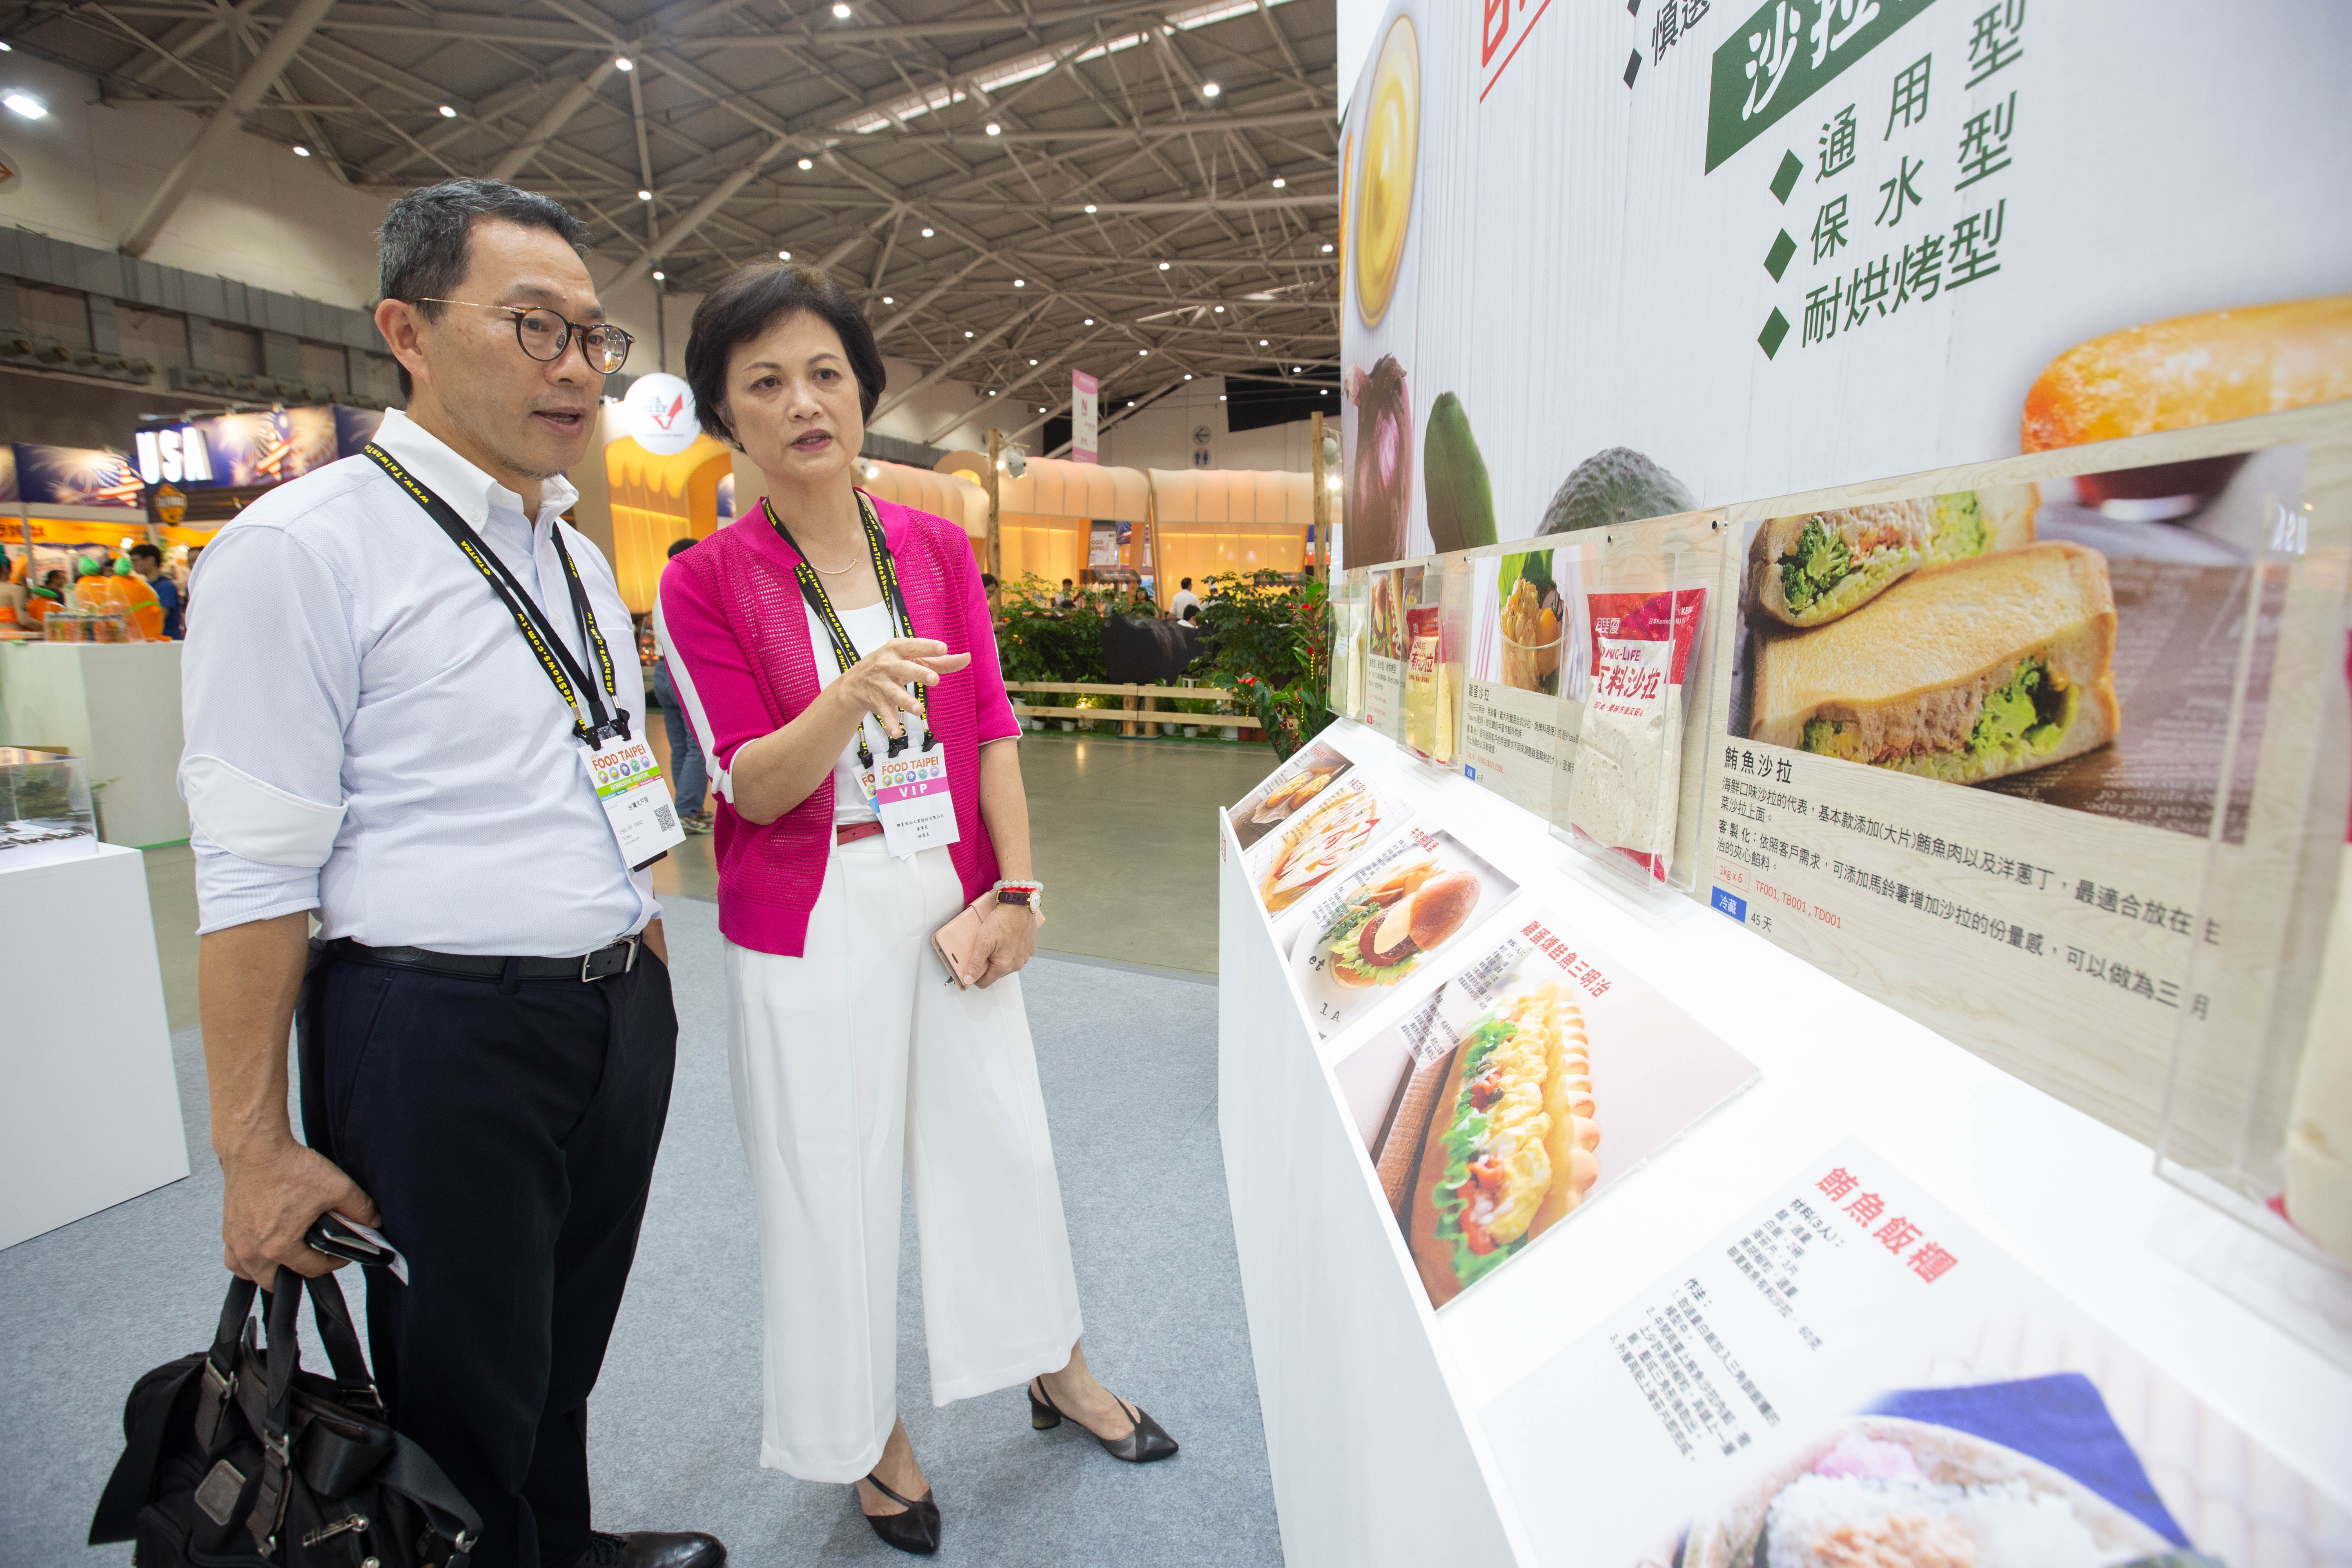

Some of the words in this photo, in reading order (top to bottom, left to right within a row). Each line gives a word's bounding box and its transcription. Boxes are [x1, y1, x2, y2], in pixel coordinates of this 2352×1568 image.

[1811, 90, 2018, 266] 保水型
[1801, 198, 2007, 349] 耐烘烤型
[136, 427, 212, 484] USA
[461, 540, 486, 568] TAITRA
[886, 559, 896, 582] TAITRA
[1468, 684, 1490, 702] 雞蛋沙拉
[592, 752, 619, 771] FOOD
[618, 744, 646, 762] TAIPEI
[882, 762, 908, 775] FOOD
[910, 756, 939, 770] TAIPEI
[1724, 745, 1793, 784] 鮪魚沙拉
[610, 777, 633, 791] DOMESTIC
[633, 772, 649, 782] VISITOR
[898, 783, 928, 798] VIP
[1720, 795, 1772, 823] 菜沙拉上面。
[1720, 865, 1731, 880] 1kg
[1738, 873, 1743, 883] 6
[1719, 894, 1737, 915] 冷藏
[1755, 880, 1780, 902] TF001,
[1814, 906, 1842, 929] TD001
[1751, 913, 1760, 926] 45
[1762, 915, 1772, 933] 天
[1520, 920, 1612, 998] 雞蛋燻鮭魚三明治
[1814, 1167, 1959, 1284] 鮪魚飯糰
